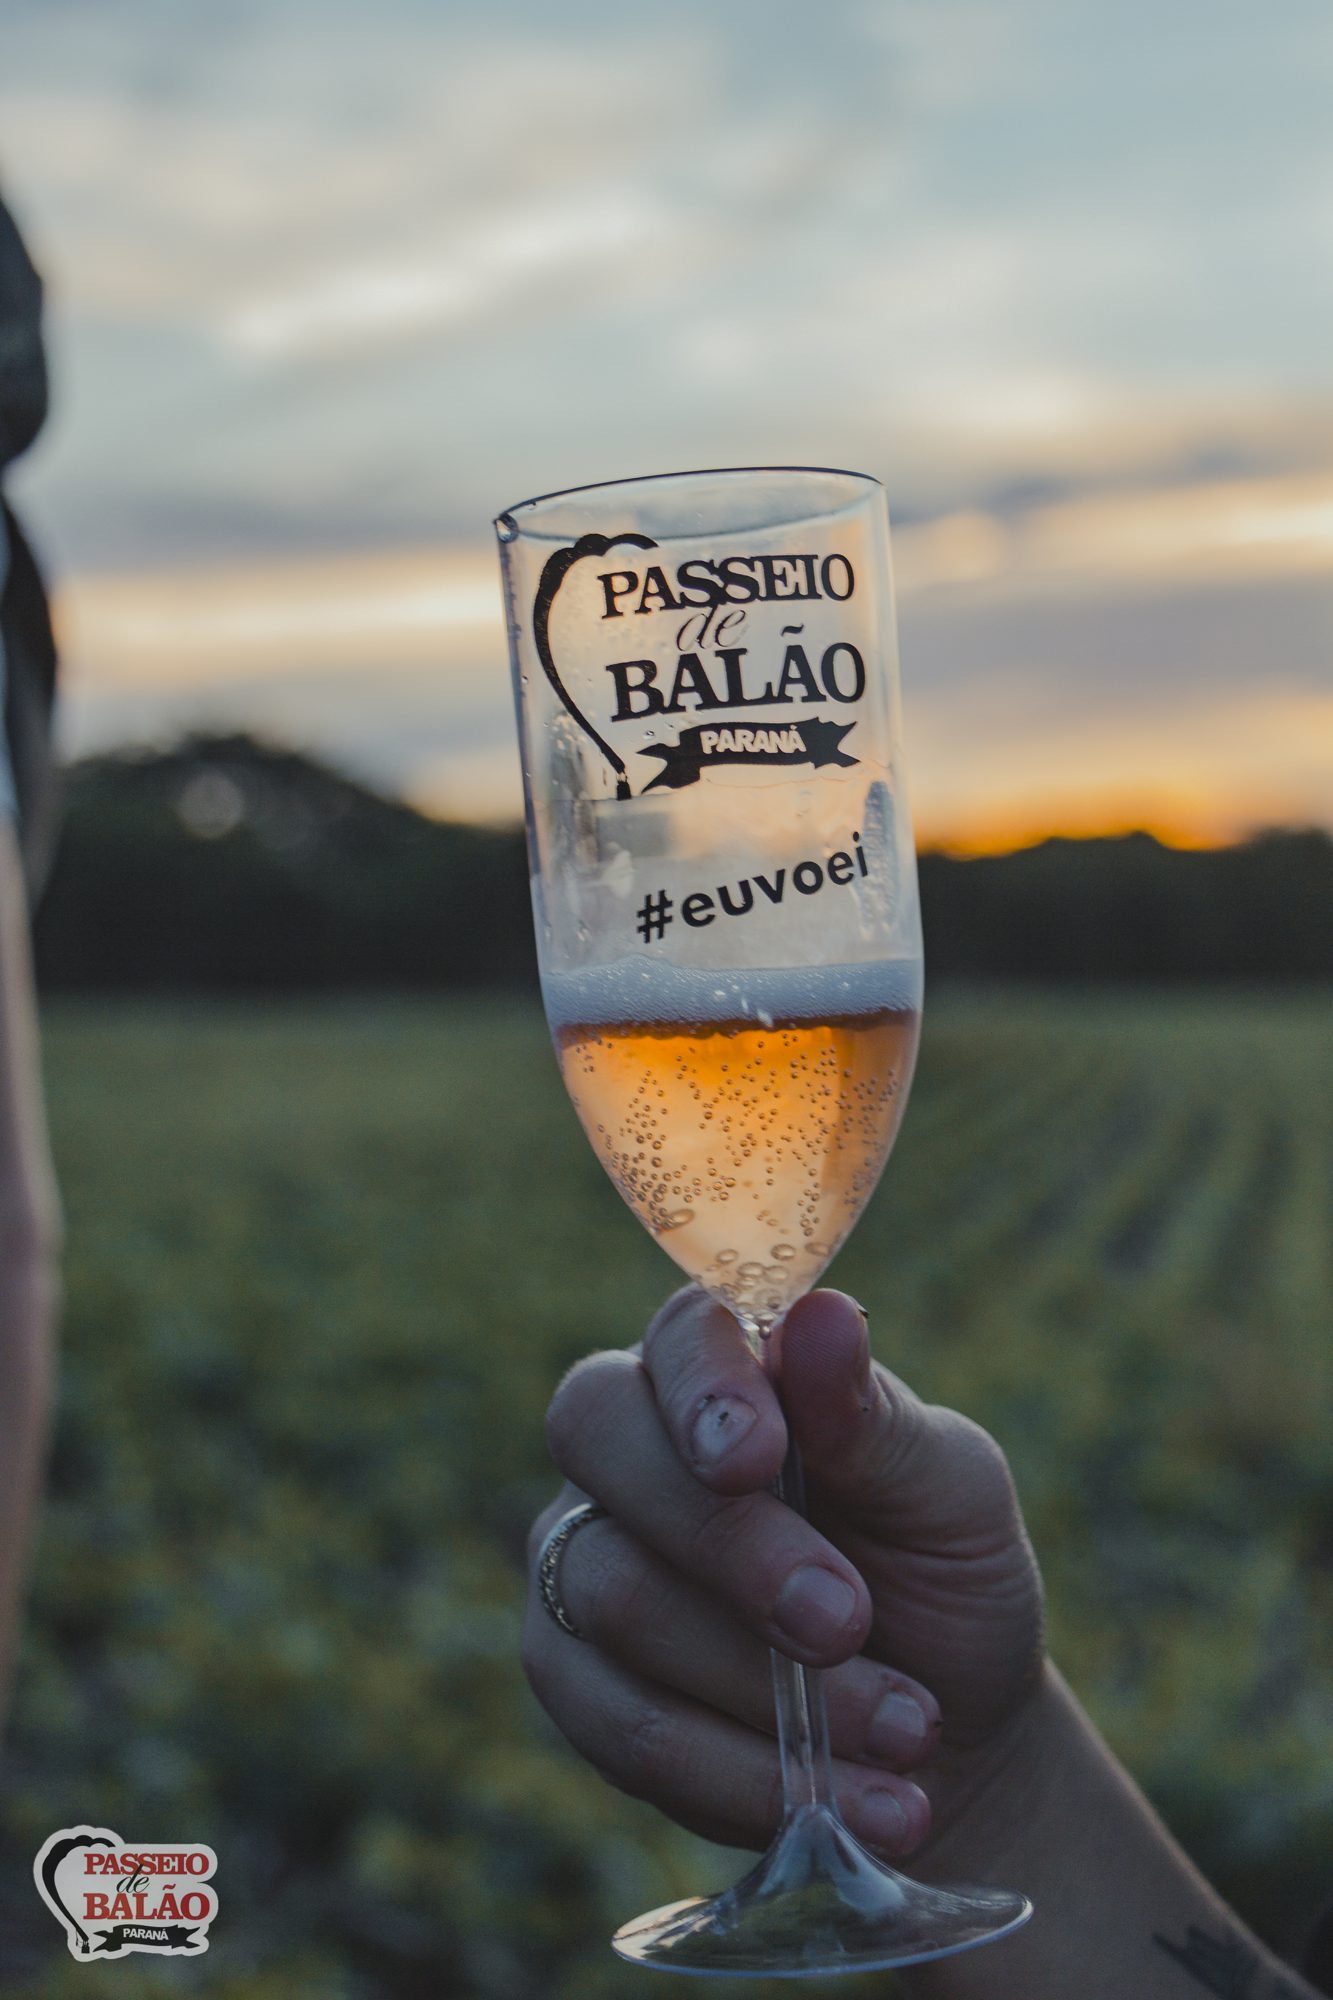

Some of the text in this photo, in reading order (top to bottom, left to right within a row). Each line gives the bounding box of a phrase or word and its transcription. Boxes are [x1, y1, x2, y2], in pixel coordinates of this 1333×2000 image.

[597, 553, 856, 620] PASSEIO
[676, 598, 747, 652] de
[605, 624, 867, 723] BALÃO
[700, 724, 807, 755] PARANÁ
[636, 831, 870, 944] #euvoei
